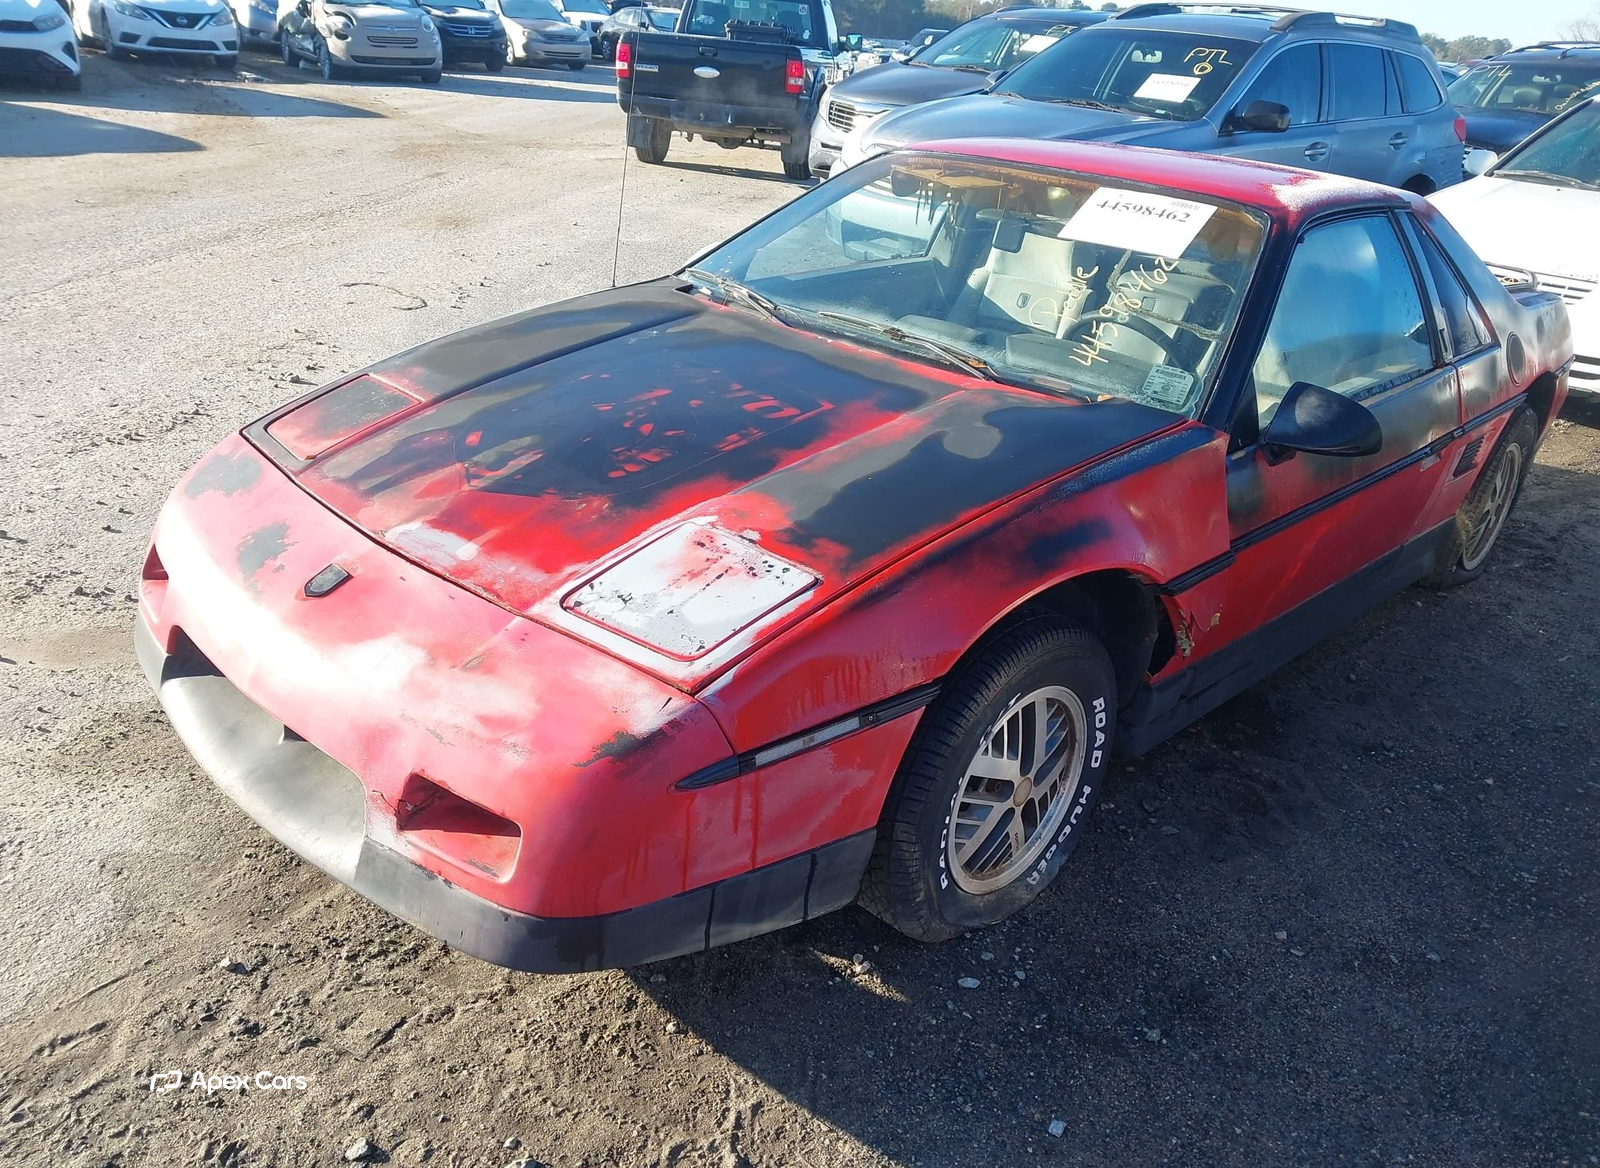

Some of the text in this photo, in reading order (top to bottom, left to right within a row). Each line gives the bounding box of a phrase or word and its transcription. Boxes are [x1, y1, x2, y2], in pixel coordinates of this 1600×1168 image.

[1183, 47, 1233, 66] PTL
[1096, 199, 1192, 223] 44598462
[1068, 256, 1180, 366] 44598462
[1026, 696, 1107, 886] ROAD HUGGER
